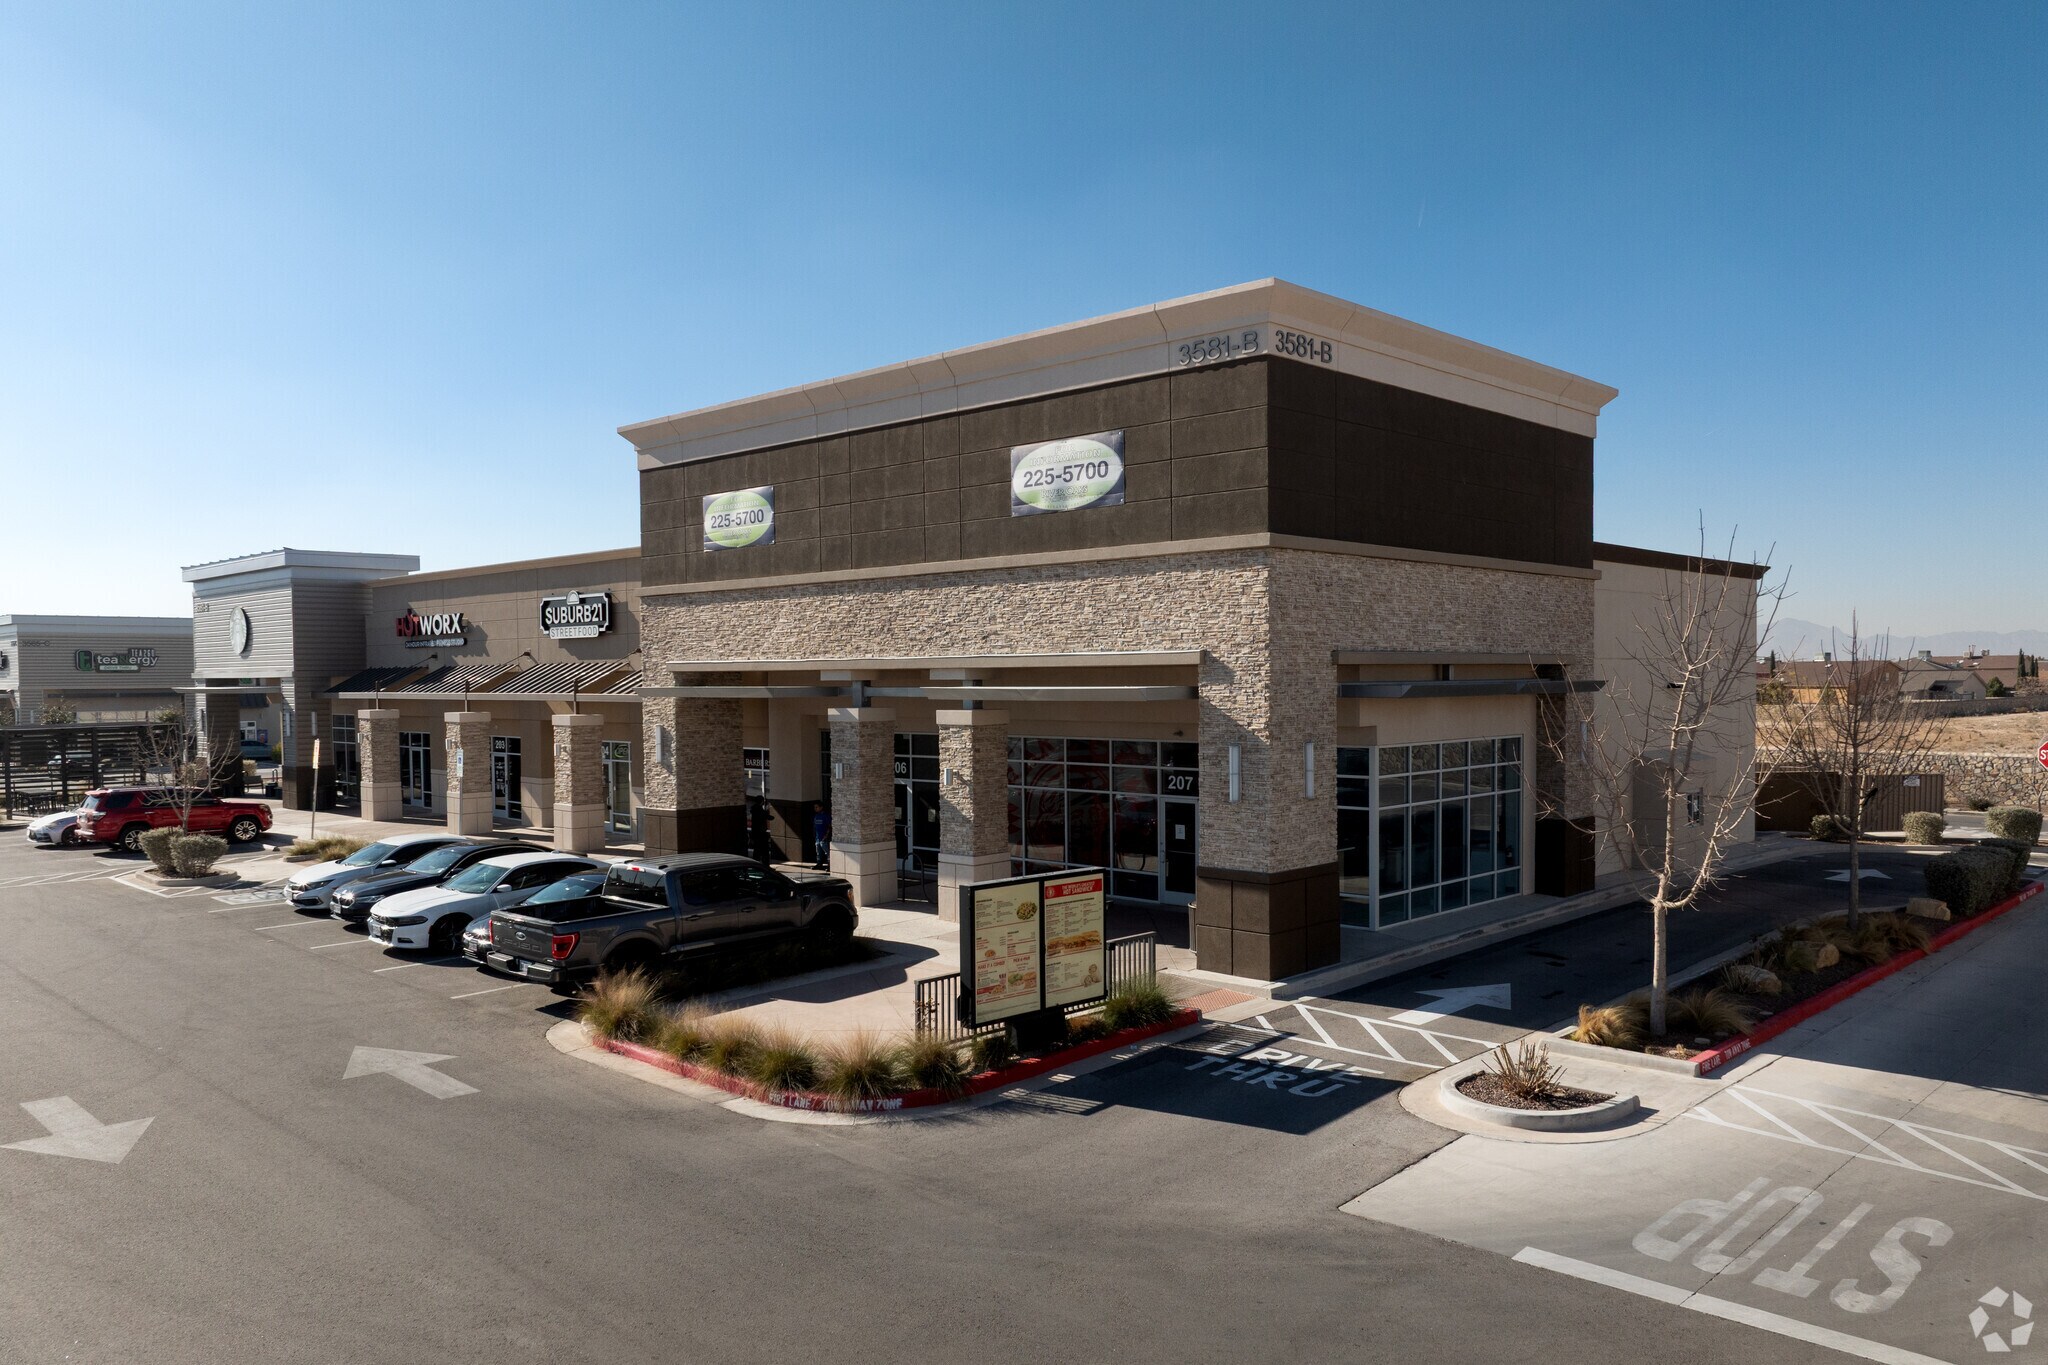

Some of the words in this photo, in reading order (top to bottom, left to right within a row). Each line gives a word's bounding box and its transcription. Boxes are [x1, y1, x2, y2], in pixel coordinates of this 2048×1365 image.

[1179, 331, 1259, 365] 3581-B
[1275, 330, 1333, 363] 3581-B
[1030, 449, 1101, 466] INFORMATION
[1023, 460, 1109, 488] 225-5700
[710, 509, 764, 529] 225-5700
[396, 611, 461, 638] HOTWORX
[545, 603, 603, 624] SUBURB21
[495, 740, 506, 750] 203
[1168, 775, 1194, 790] 207
[1206, 1039, 1385, 1084] DRIVE
[1184, 1055, 1345, 1097] THRU
[1632, 1177, 1954, 1313] STOP
